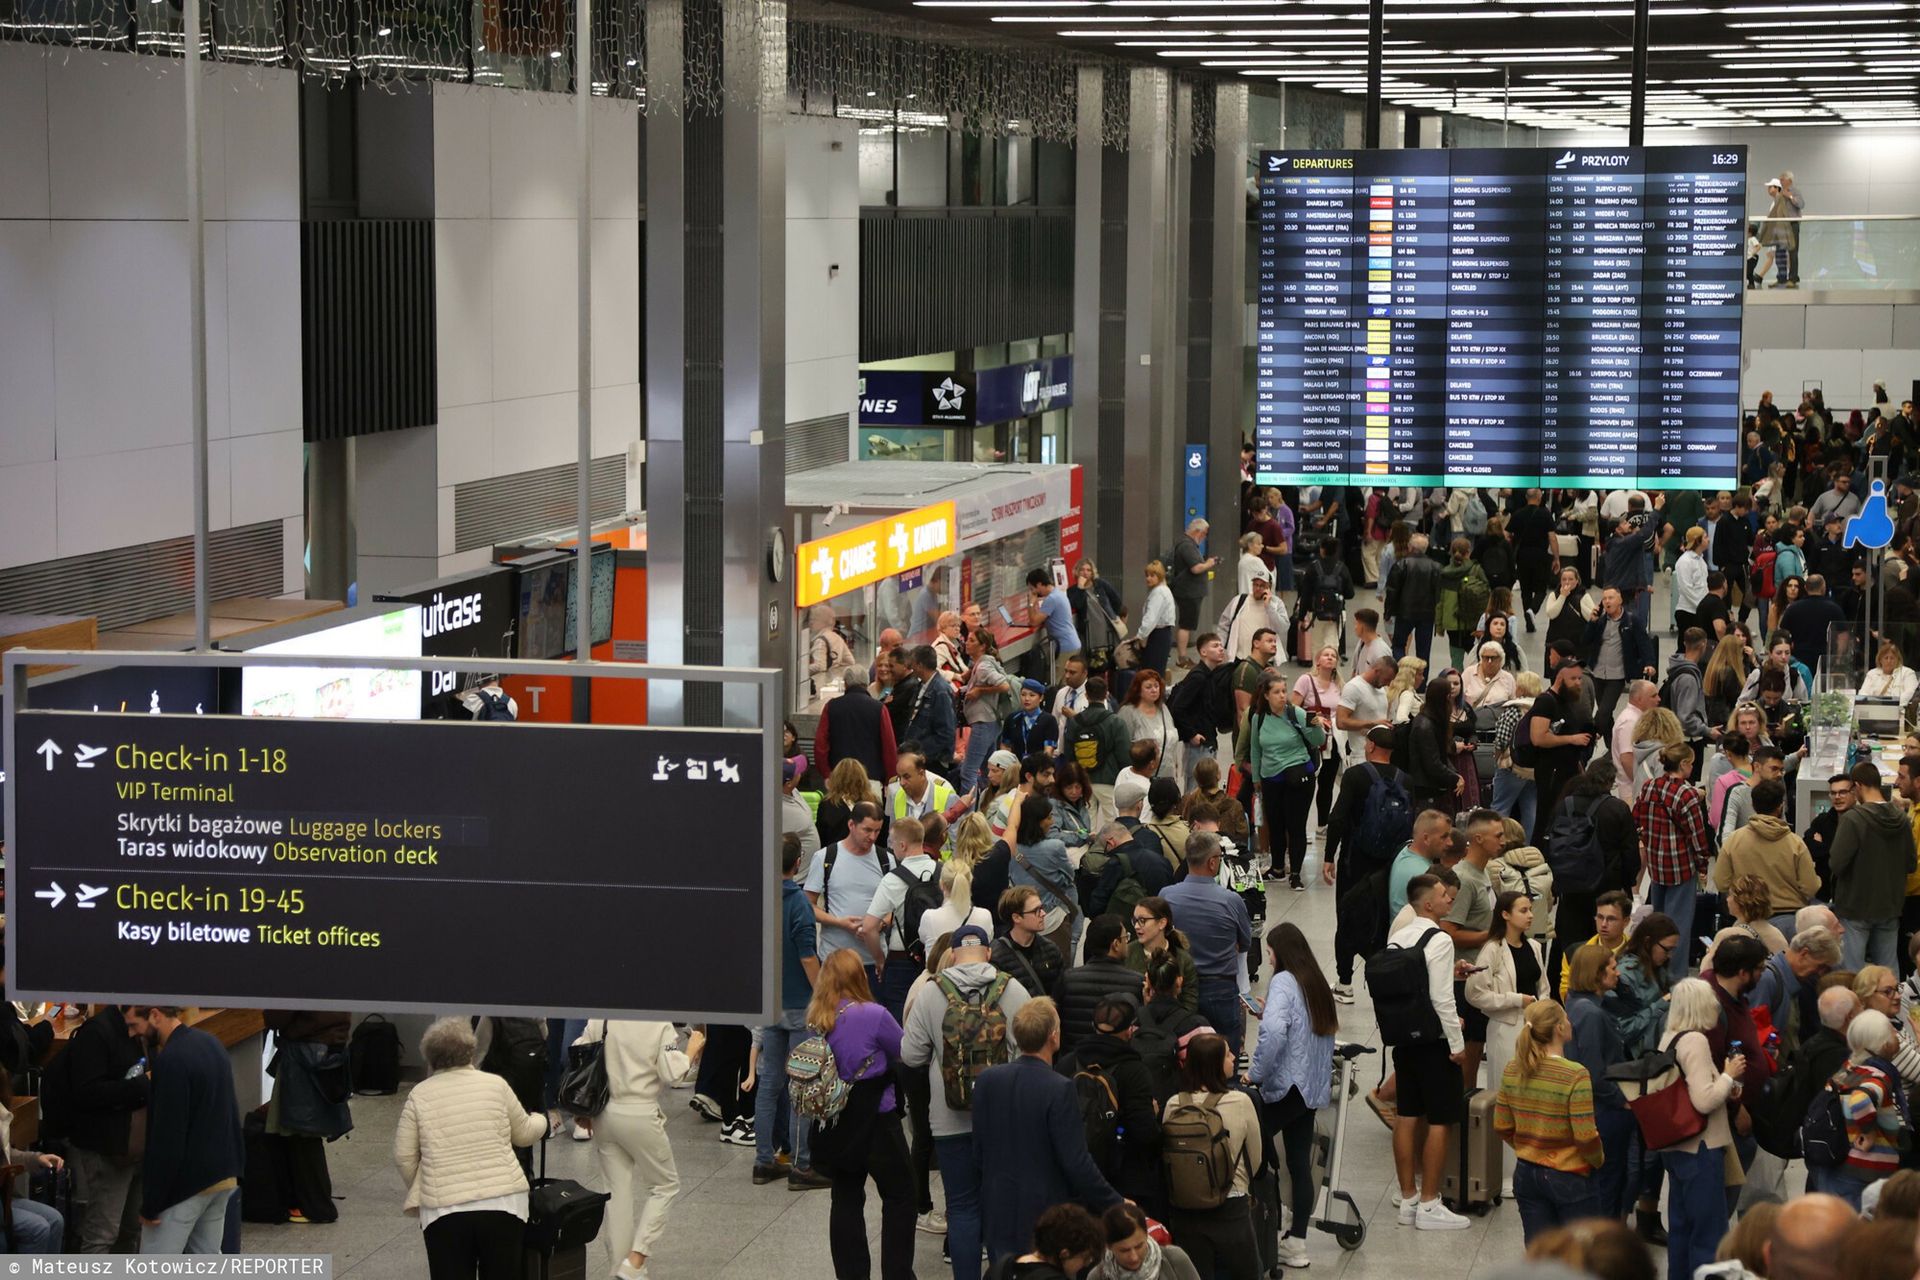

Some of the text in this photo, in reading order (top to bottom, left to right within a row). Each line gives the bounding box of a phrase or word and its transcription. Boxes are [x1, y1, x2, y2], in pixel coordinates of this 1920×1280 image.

[1293, 159, 1353, 169] DEPARTURES
[1582, 156, 1629, 166] PRZYLOTY
[1712, 154, 1738, 164] 16:29
[860, 399, 898, 413] NES
[423, 592, 481, 638] uitcase
[115, 744, 287, 774] Check-in 1-18
[116, 782, 234, 803] VIP Terminal
[117, 812, 442, 841] Skrytki bagażowe Luggage lockers
[117, 838, 438, 866] Taras widokowy Observation deck
[116, 884, 305, 914] Check-in 19-45
[118, 921, 381, 948] Kasy biletowe Ticket offices
